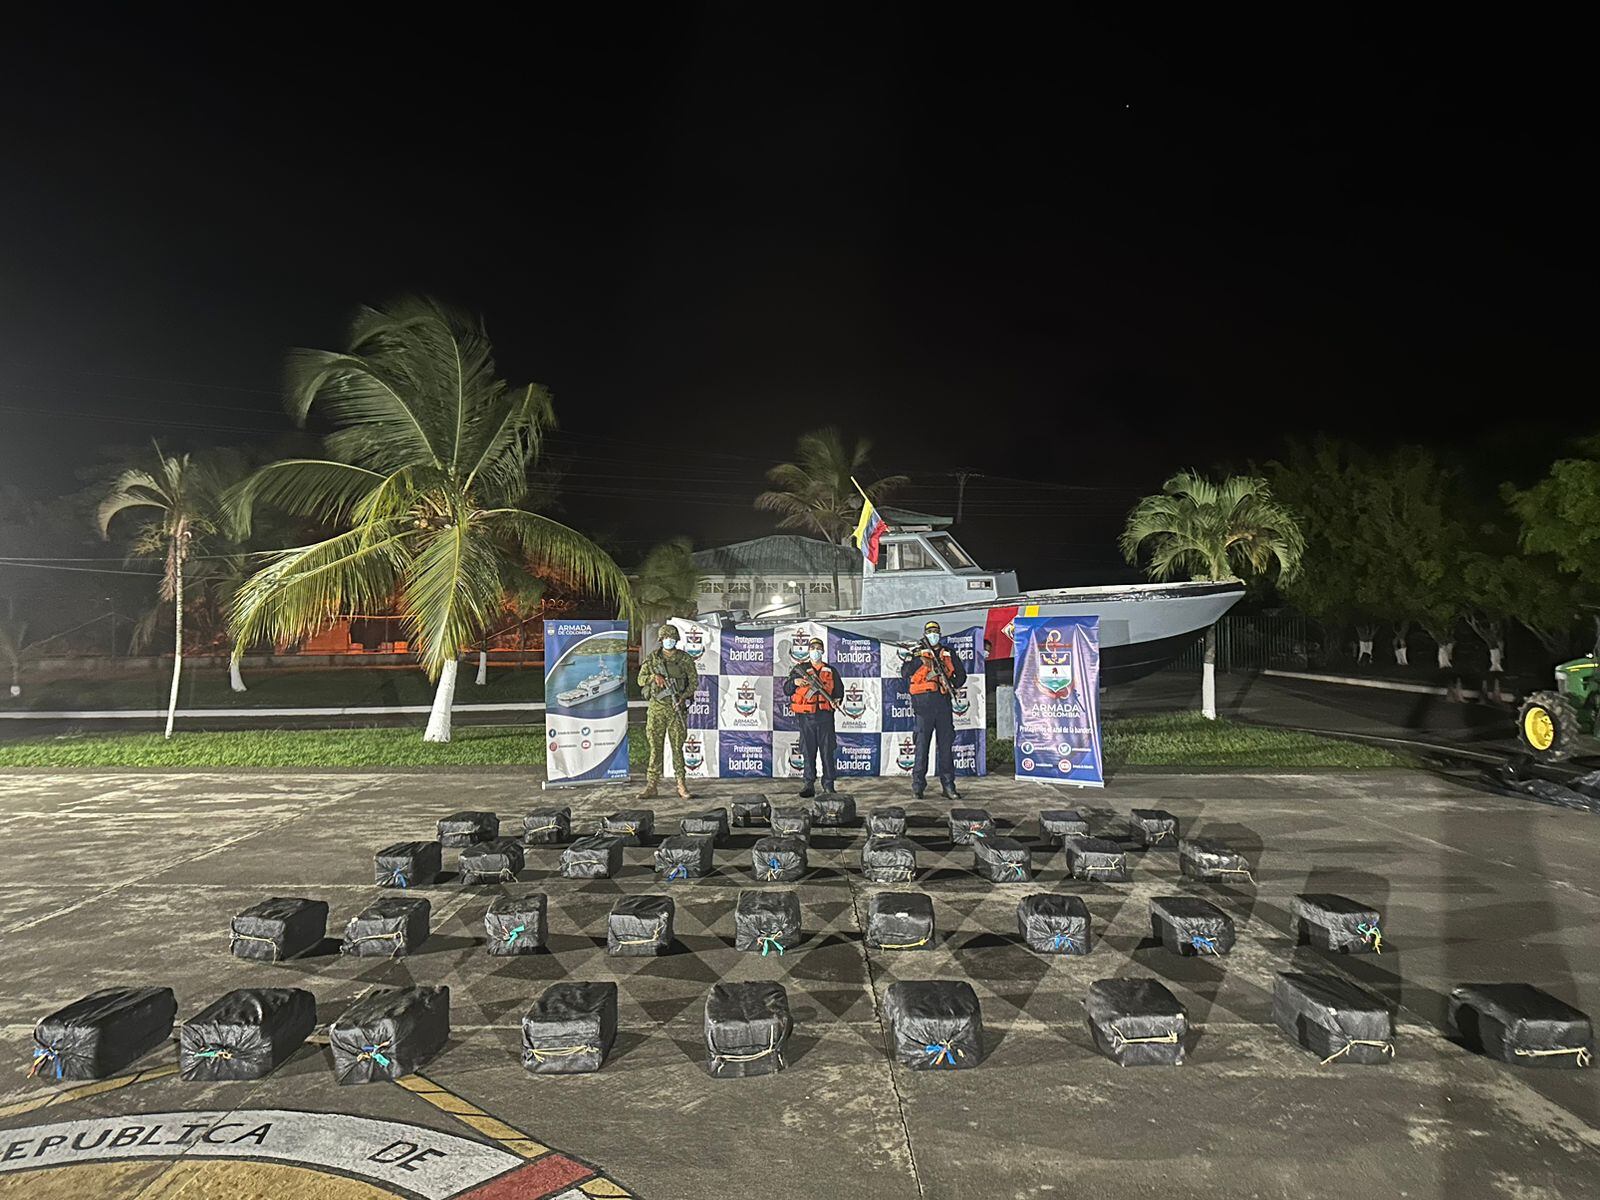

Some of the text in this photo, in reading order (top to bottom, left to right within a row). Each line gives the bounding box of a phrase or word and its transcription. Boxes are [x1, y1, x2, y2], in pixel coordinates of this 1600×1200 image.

[734, 636, 764, 644] Protegemos
[730, 648, 764, 661] bandera
[837, 650, 871, 663] bandera
[734, 745, 762, 753] Protegemos
[729, 757, 762, 770] bandera
[836, 759, 870, 770] bandera
[0, 1122, 448, 1172] EPUBLICA DE
